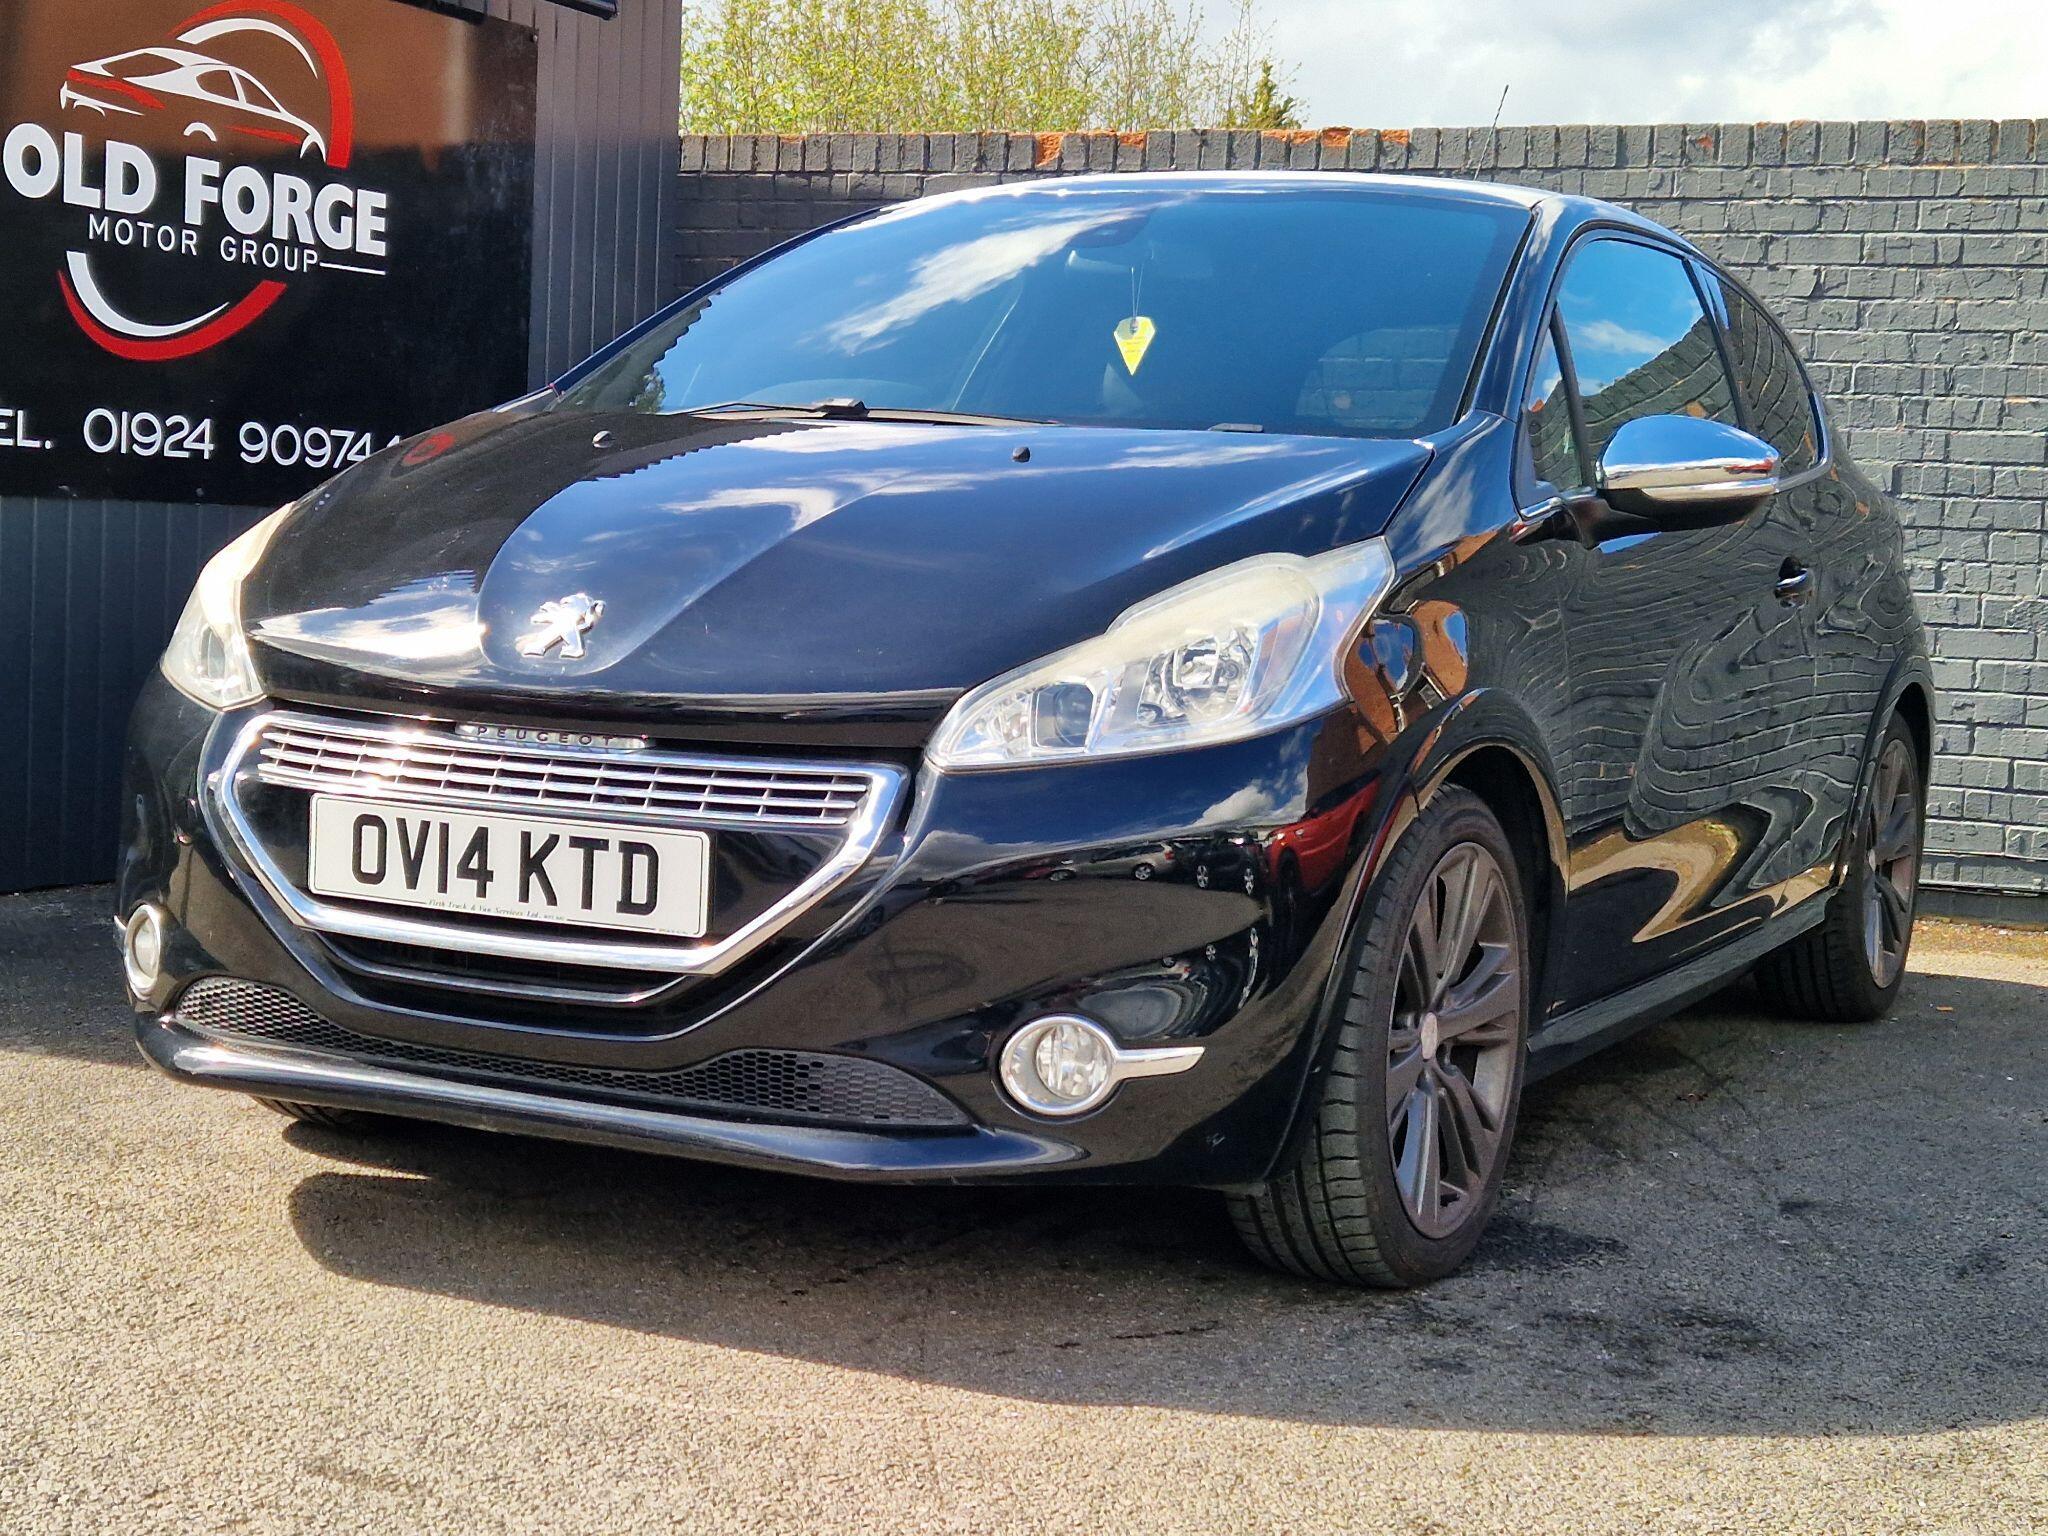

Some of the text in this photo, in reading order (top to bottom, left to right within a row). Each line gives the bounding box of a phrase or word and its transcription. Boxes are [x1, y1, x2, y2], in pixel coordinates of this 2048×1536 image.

[2, 122, 387, 257] OLD FORGE
[88, 213, 319, 273] MOTOR GROUP
[83, 407, 215, 460] 01924
[238, 421, 400, 469] 90974
[476, 725, 614, 747] PEUGEOT
[351, 813, 660, 916] OV14 KTD
